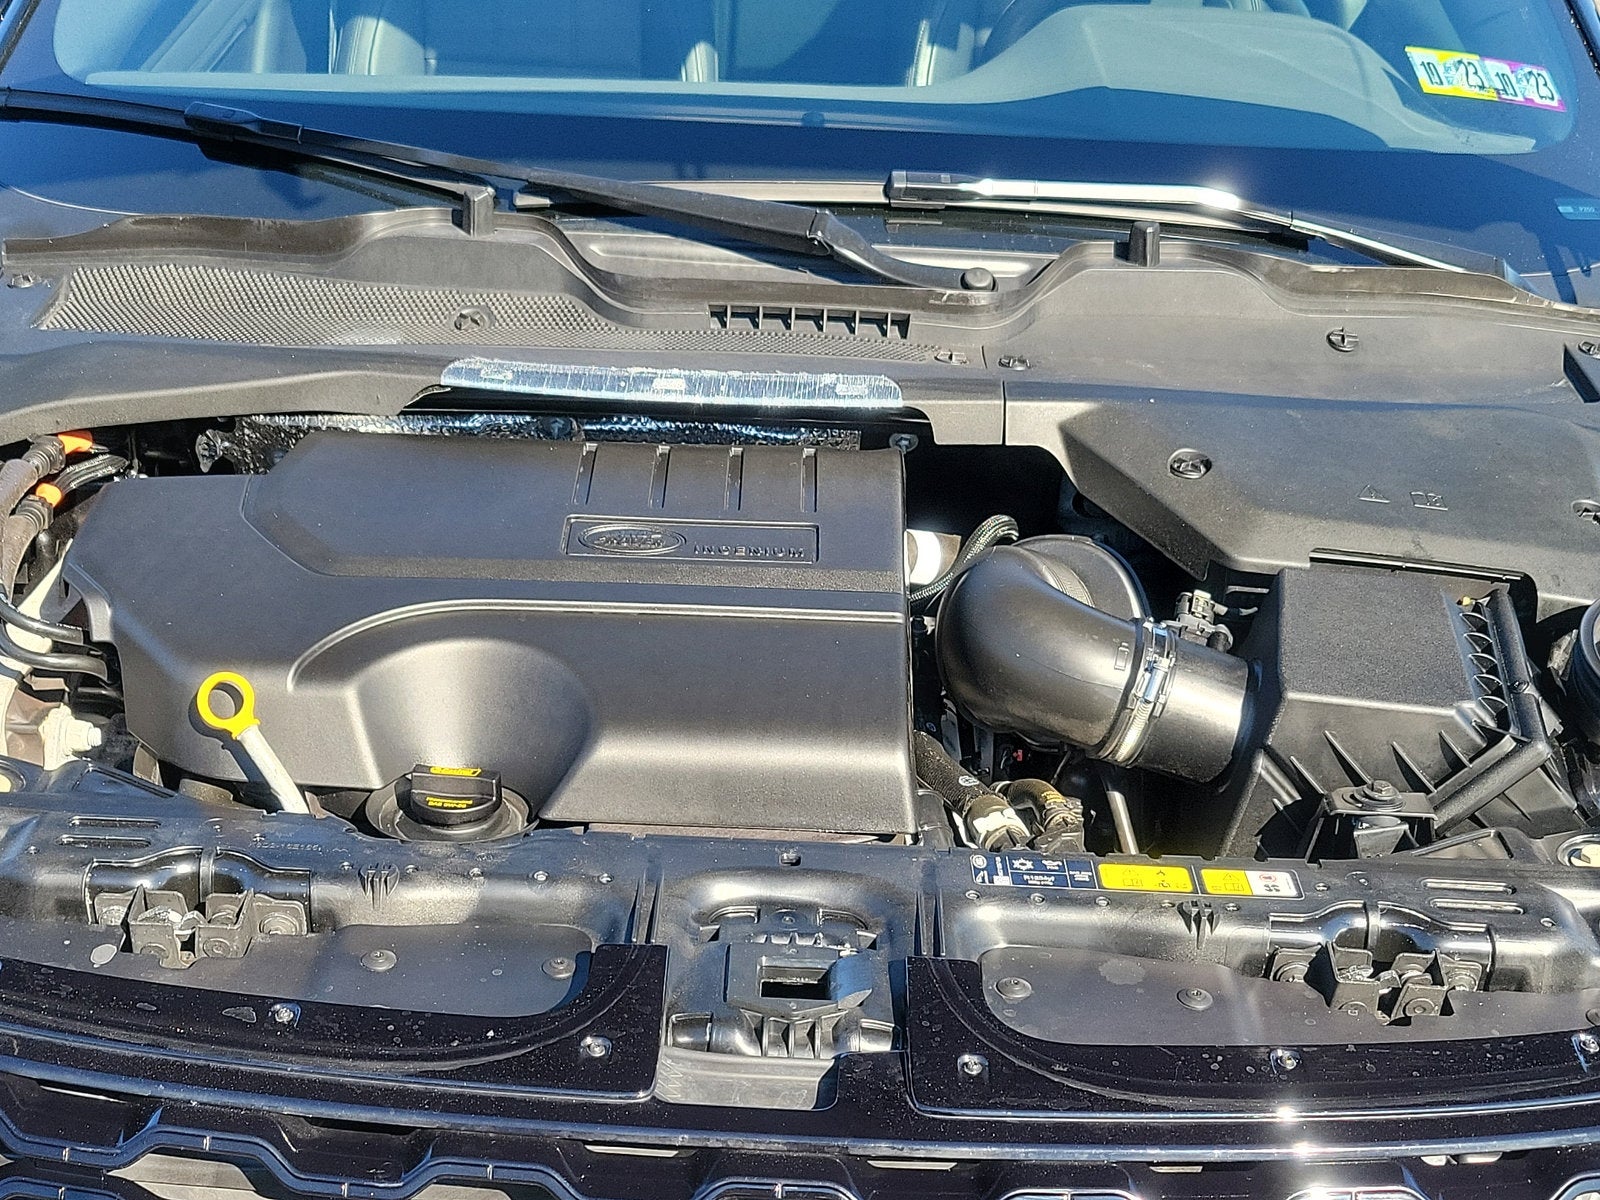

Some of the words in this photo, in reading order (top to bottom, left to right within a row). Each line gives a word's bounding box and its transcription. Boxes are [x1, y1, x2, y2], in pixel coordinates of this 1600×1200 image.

[1420, 61, 1444, 86] 10
[1455, 59, 1485, 91] 23
[1495, 72, 1518, 97] 10
[1527, 70, 1555, 101] 23
[693, 543, 805, 557] INGENIUM
